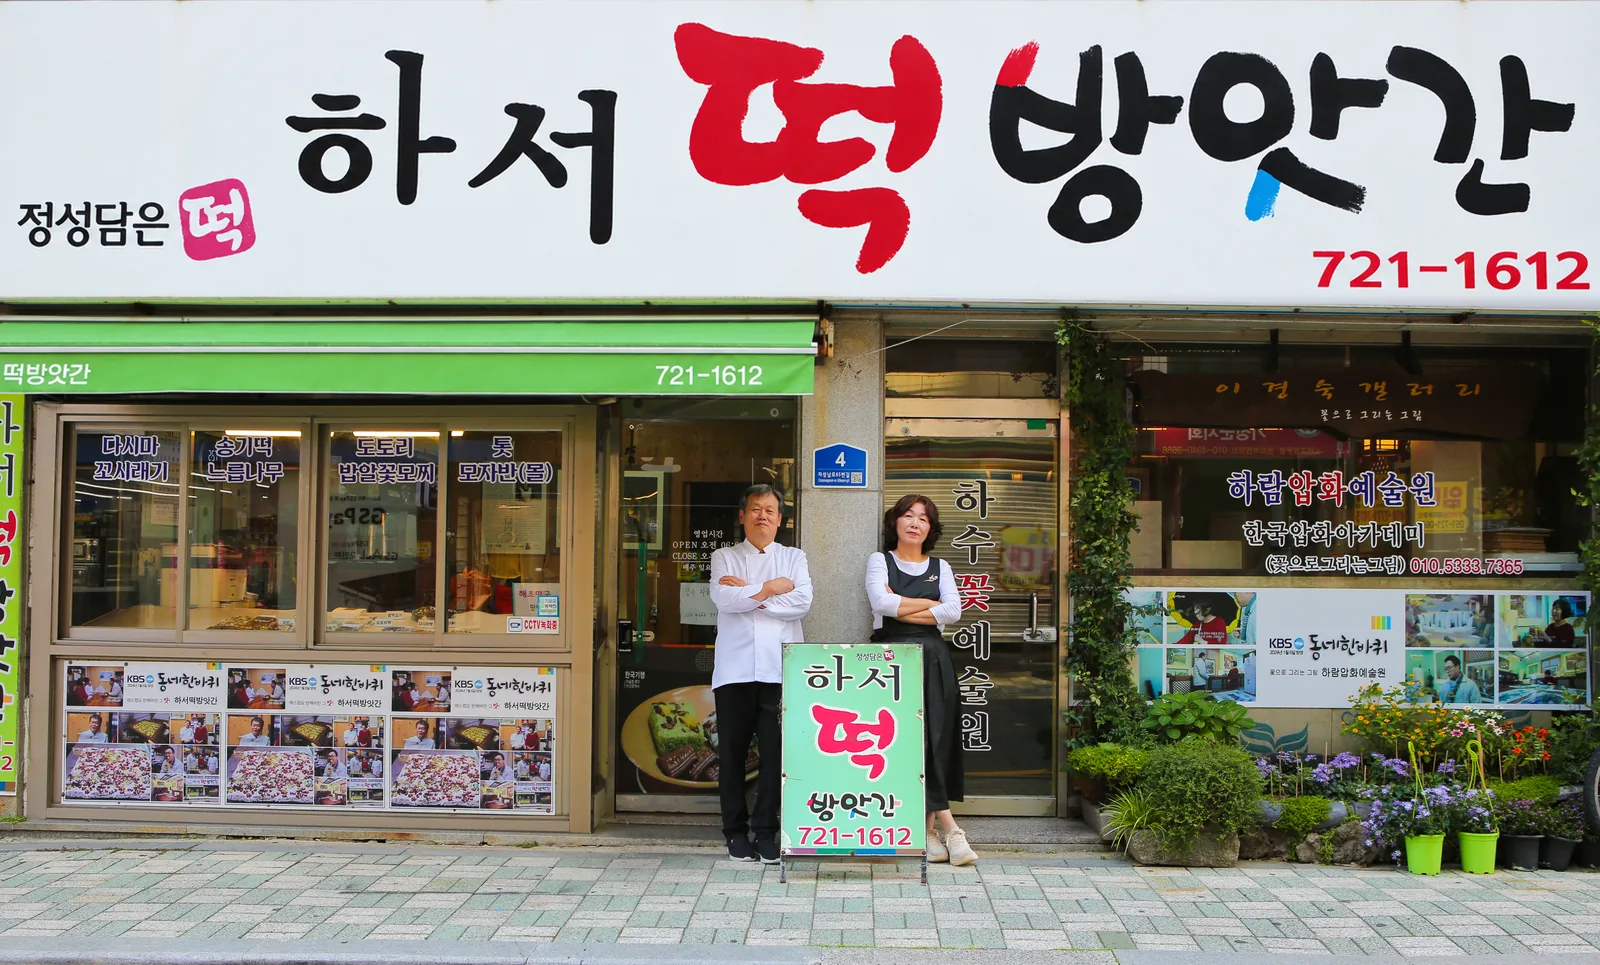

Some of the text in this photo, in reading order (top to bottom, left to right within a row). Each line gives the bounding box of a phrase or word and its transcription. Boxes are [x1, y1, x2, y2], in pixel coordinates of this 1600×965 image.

[285, 22, 1575, 274] 하서 떡 방앗간
[17, 188, 243, 252] 정성담은 떡
[1312, 250, 1591, 290] 721-1612
[3, 363, 91, 386] 떡방앗간
[655, 365, 762, 386] 721-1612
[1360, 409, 1393, 421] 그리는
[1400, 410, 1423, 422] 그림
[102, 435, 160, 456] 다시마
[215, 436, 273, 457] 송기떡
[356, 436, 414, 458] 도토리
[492, 436, 513, 458] 톳
[835, 451, 847, 467] 4
[93, 461, 169, 482] 꼬시래기
[207, 462, 284, 483] 느릅나무
[338, 462, 436, 485] 밥알꽃모찌
[458, 462, 553, 484] 모자반(몰)
[1227, 470, 1438, 507] 하람압화예술원
[693, 530, 724, 538] 영업시간
[1242, 520, 1425, 548] 한국압화아카데미
[672, 541, 698, 549] OPEN
[700, 541, 717, 549] 오전
[672, 552, 698, 560] CLOSE
[1265, 554, 1524, 575] (꽃으로그리는그림) 010.5333.7365
[951, 478, 995, 752] 하수꽃예술원
[855, 652, 883, 662] 정성담은
[1269, 638, 1293, 649] KBS
[1308, 634, 1388, 661] 동네한바퀴
[127, 672, 219, 692] KBS 동네한바퀴
[802, 654, 901, 701] 하서
[1321, 667, 1387, 678] 하람압화예술원
[289, 675, 383, 694] KBS 동네한바퀴
[454, 677, 551, 697] KBS 동네한바퀴
[174, 696, 218, 705] 하서떡방앗간
[337, 699, 382, 708] 하서떡방앗간
[504, 702, 549, 711] 하서떡방앗간
[812, 705, 895, 779] 떡
[807, 793, 896, 822] 방앗간
[798, 827, 912, 846] 721-1612
